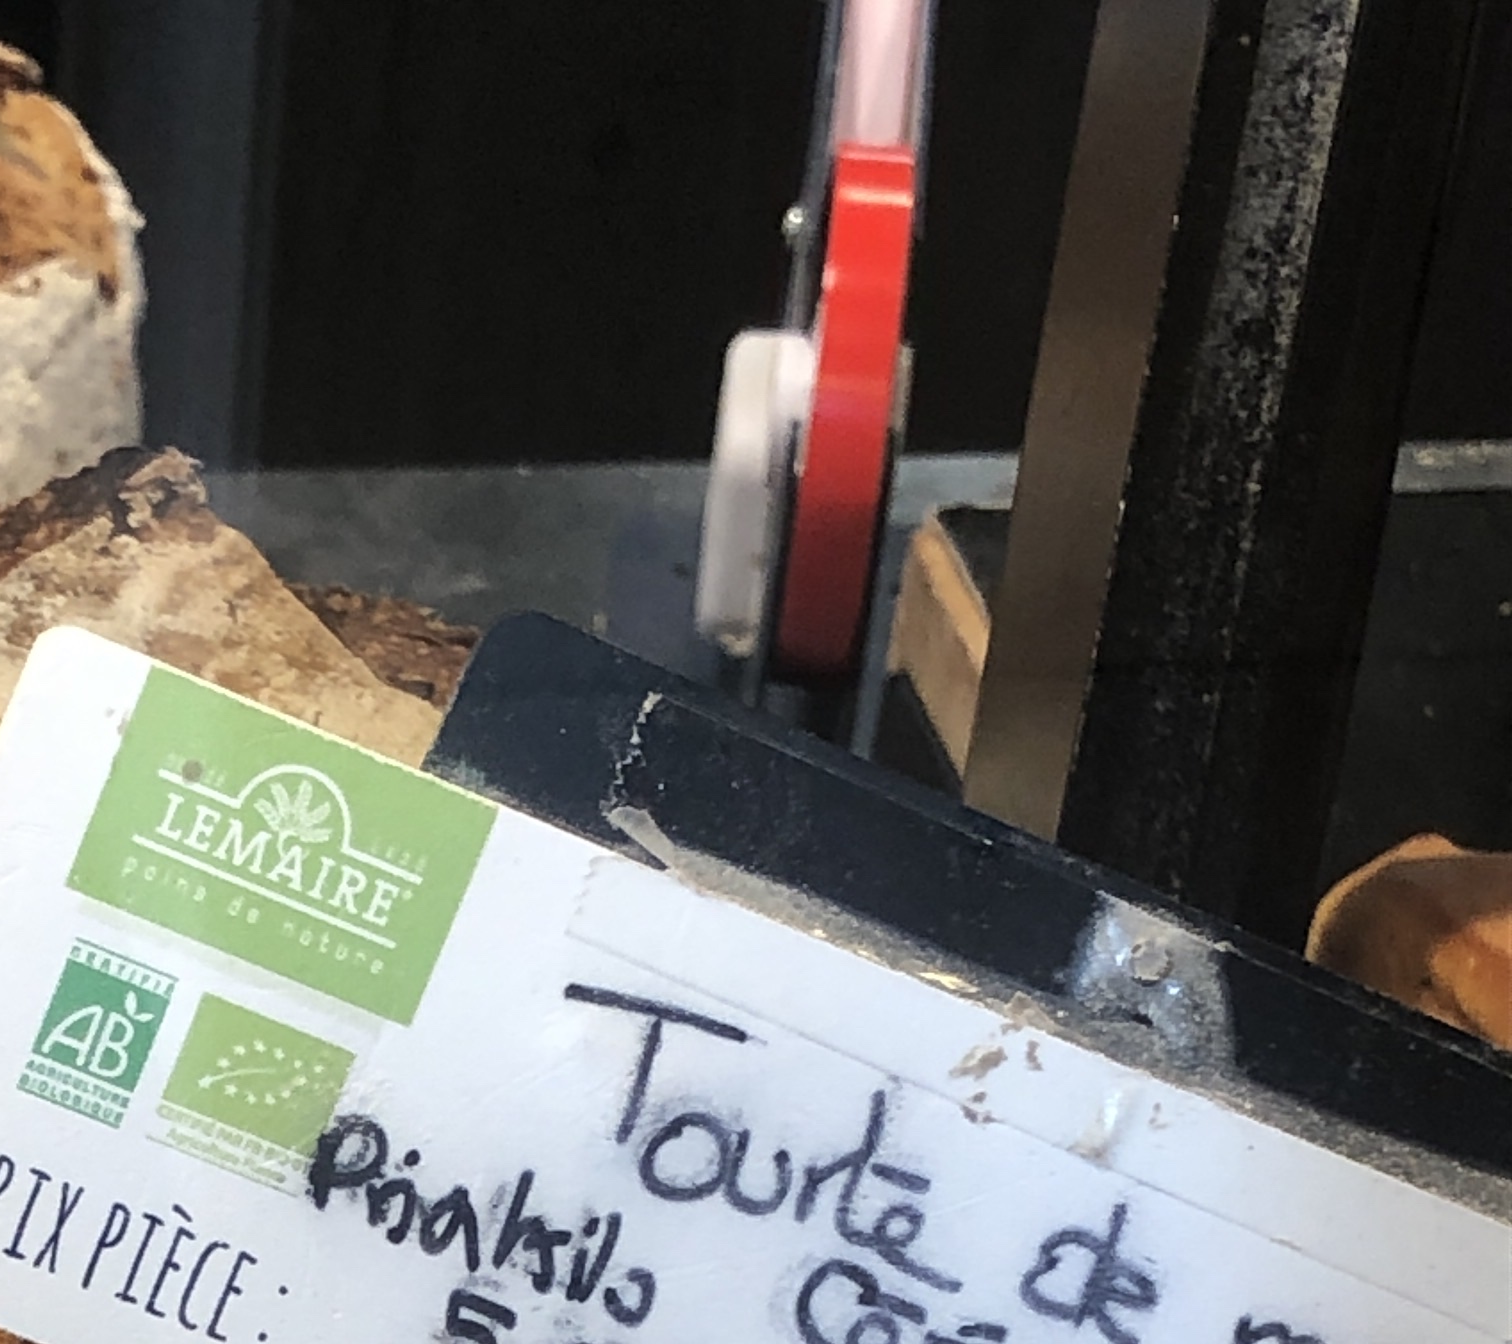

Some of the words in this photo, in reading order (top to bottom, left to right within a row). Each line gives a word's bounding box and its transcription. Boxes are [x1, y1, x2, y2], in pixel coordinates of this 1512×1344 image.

[155, 793, 400, 927] LEMAIRE
[227, 896, 261, 924] de
[40, 1004, 135, 1078] AB
